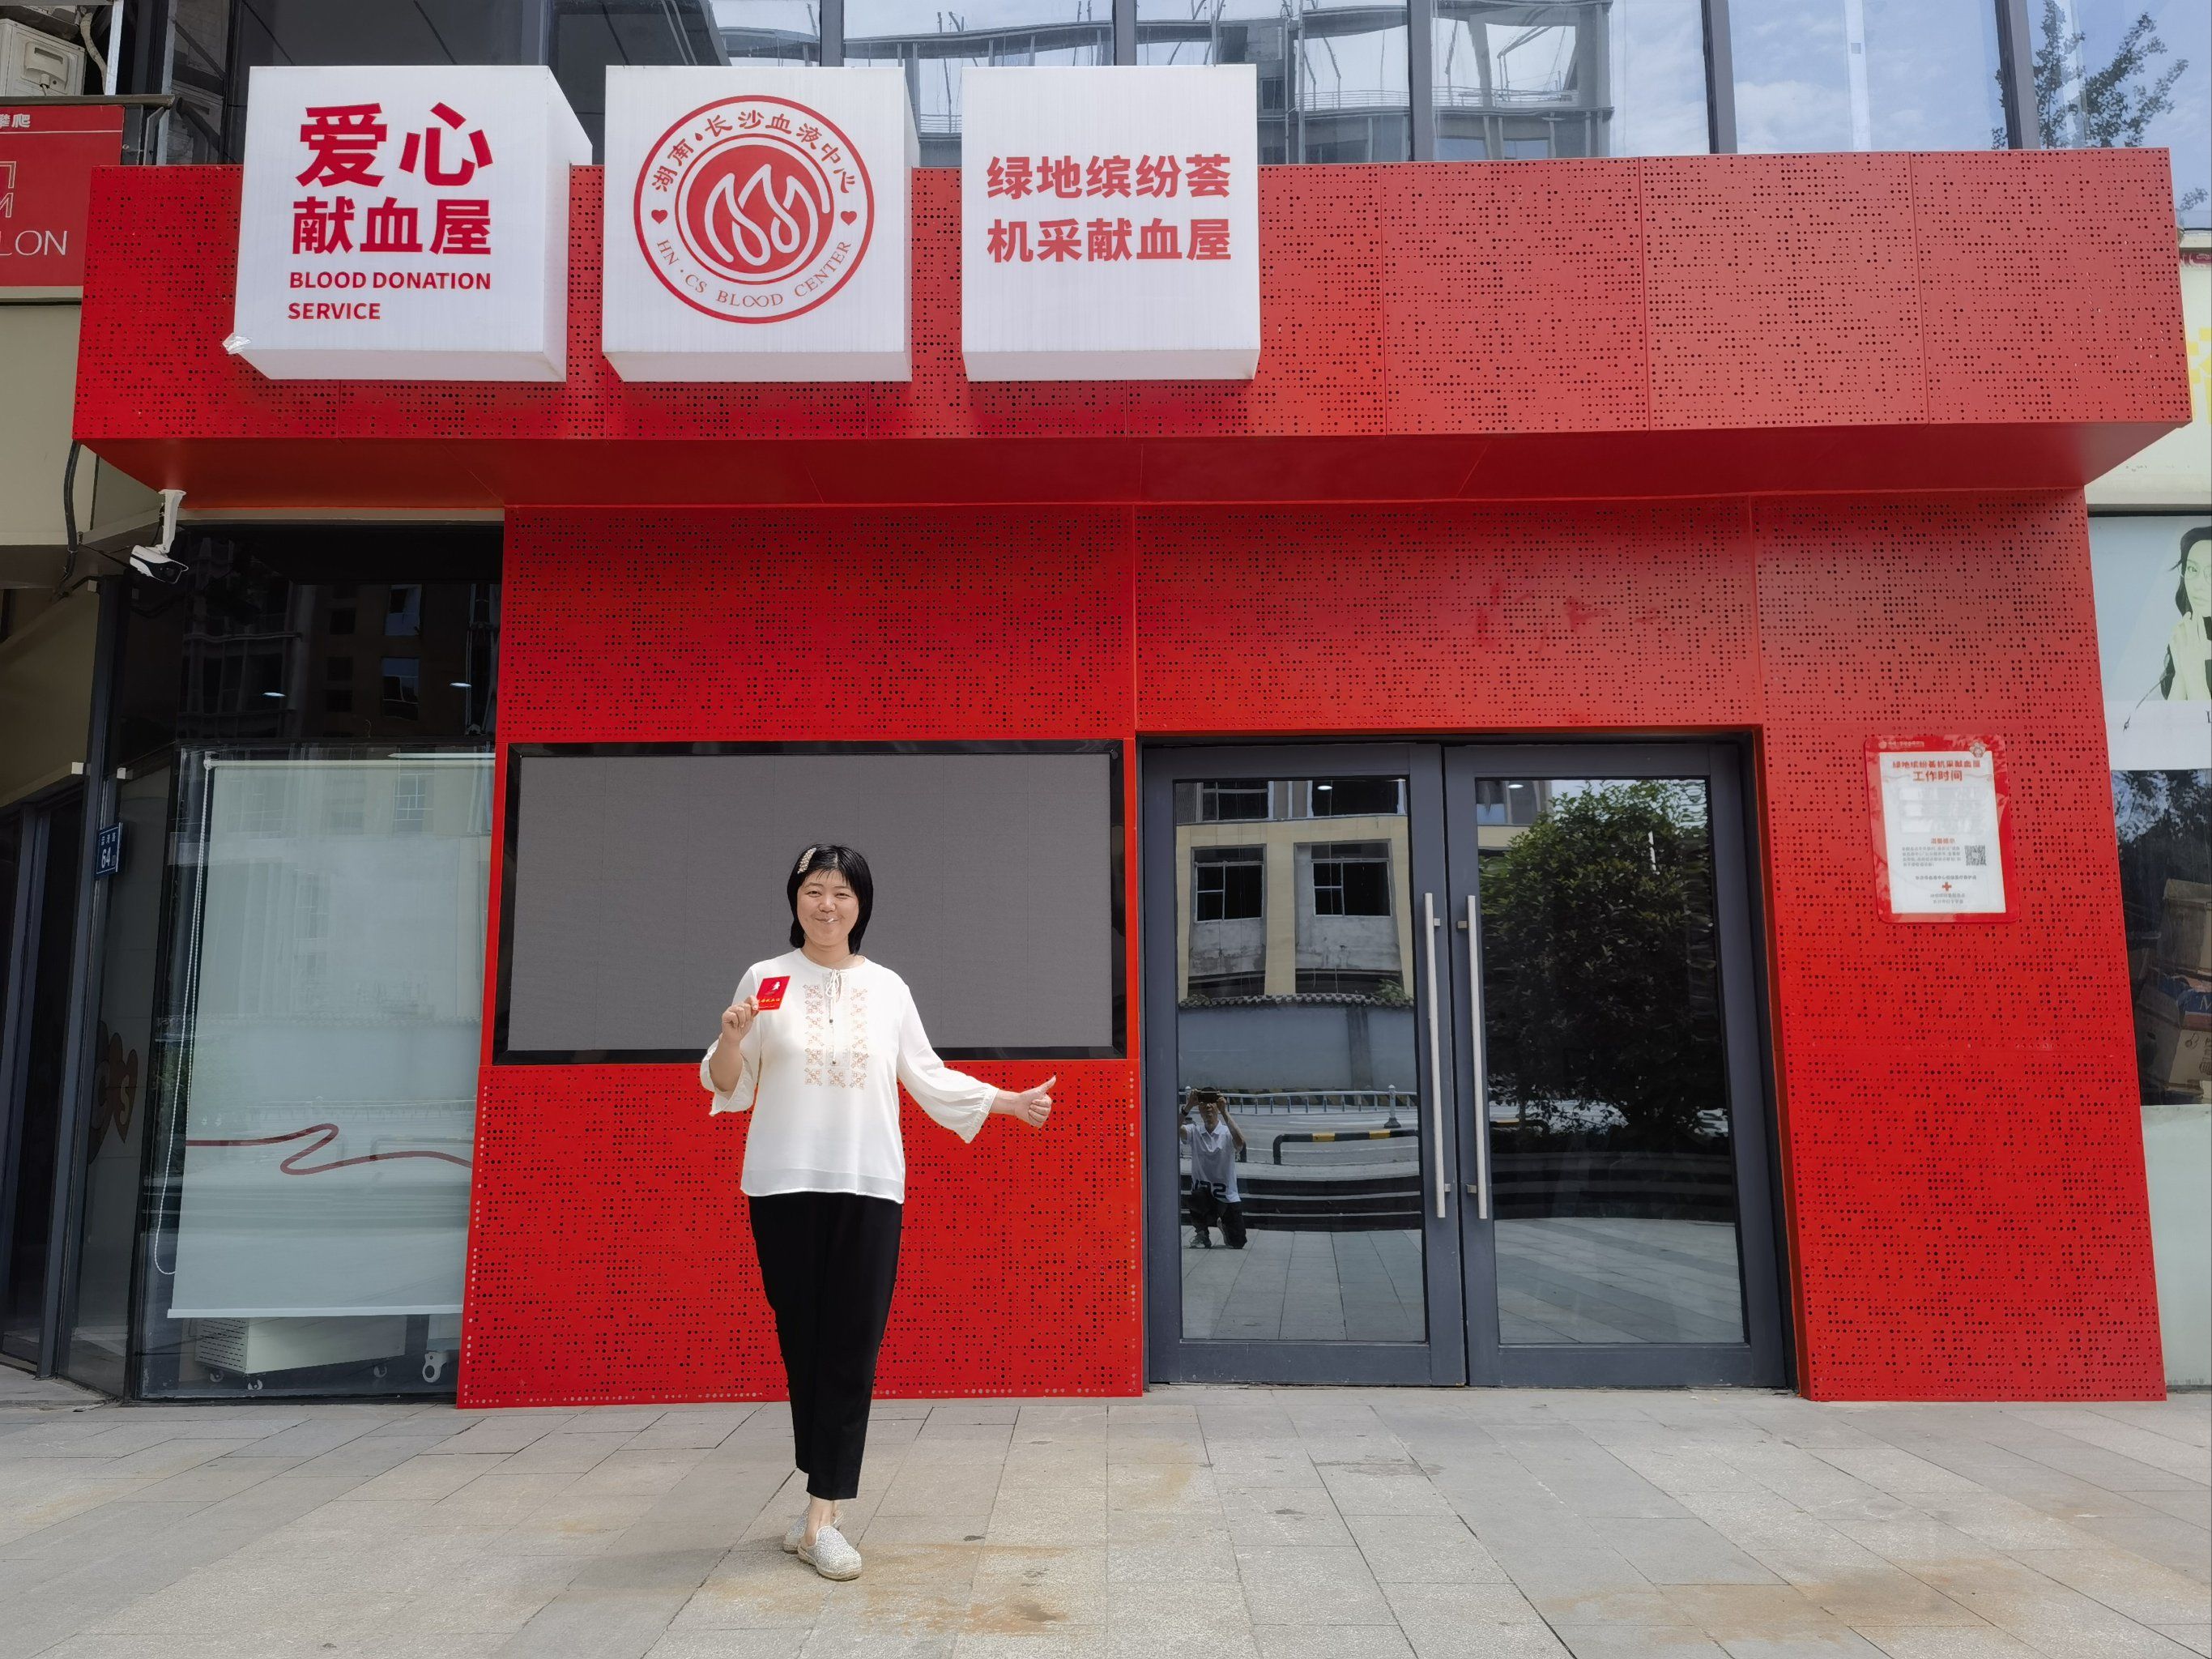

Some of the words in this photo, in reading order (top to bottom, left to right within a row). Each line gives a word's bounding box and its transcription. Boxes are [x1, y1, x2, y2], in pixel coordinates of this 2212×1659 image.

[296, 103, 493, 188] 爱心
[987, 154, 1231, 199] 绿地缤纷荟
[292, 196, 492, 255] 献血屋
[987, 218, 1231, 263] 机采献血屋
[290, 271, 367, 289] BLOOD
[373, 271, 491, 290] DONATION
[715, 289, 783, 308] BLOOD
[794, 241, 852, 297] CENTER
[288, 302, 381, 321] SERVICE
[1912, 770, 1963, 782] 工作时间
[101, 847, 111, 868] 64
